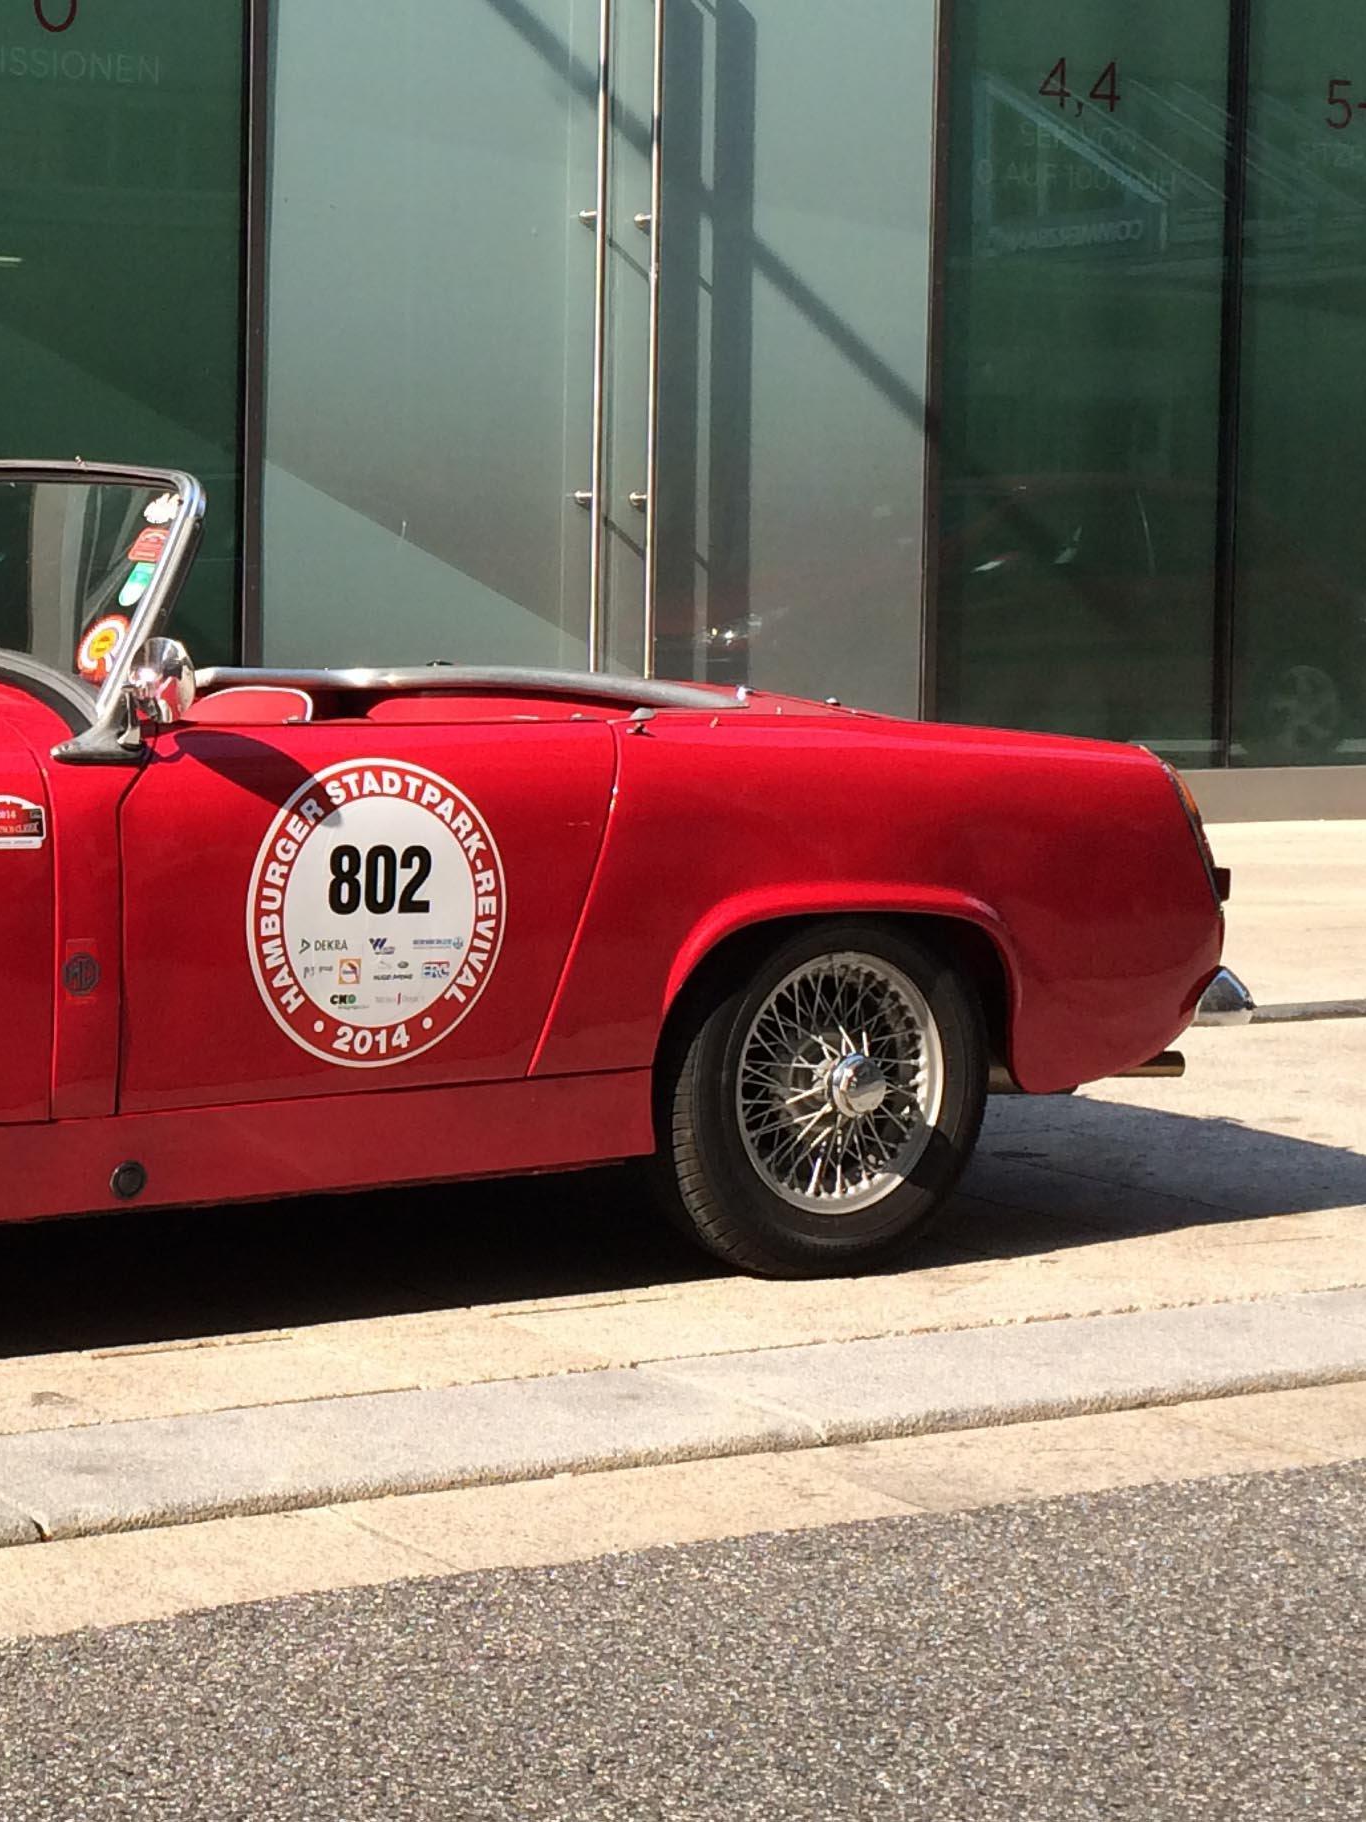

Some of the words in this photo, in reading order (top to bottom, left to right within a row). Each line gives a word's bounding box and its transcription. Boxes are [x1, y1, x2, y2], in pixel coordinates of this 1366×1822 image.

[1039, 57, 1121, 117] 4,4
[260, 797, 325, 1015] HAMBURGER
[324, 770, 498, 1004] STADTPARK-REVIVAL
[328, 844, 433, 916] 802
[314, 939, 348, 952] DEKRA
[332, 1024, 411, 1056] 2014
